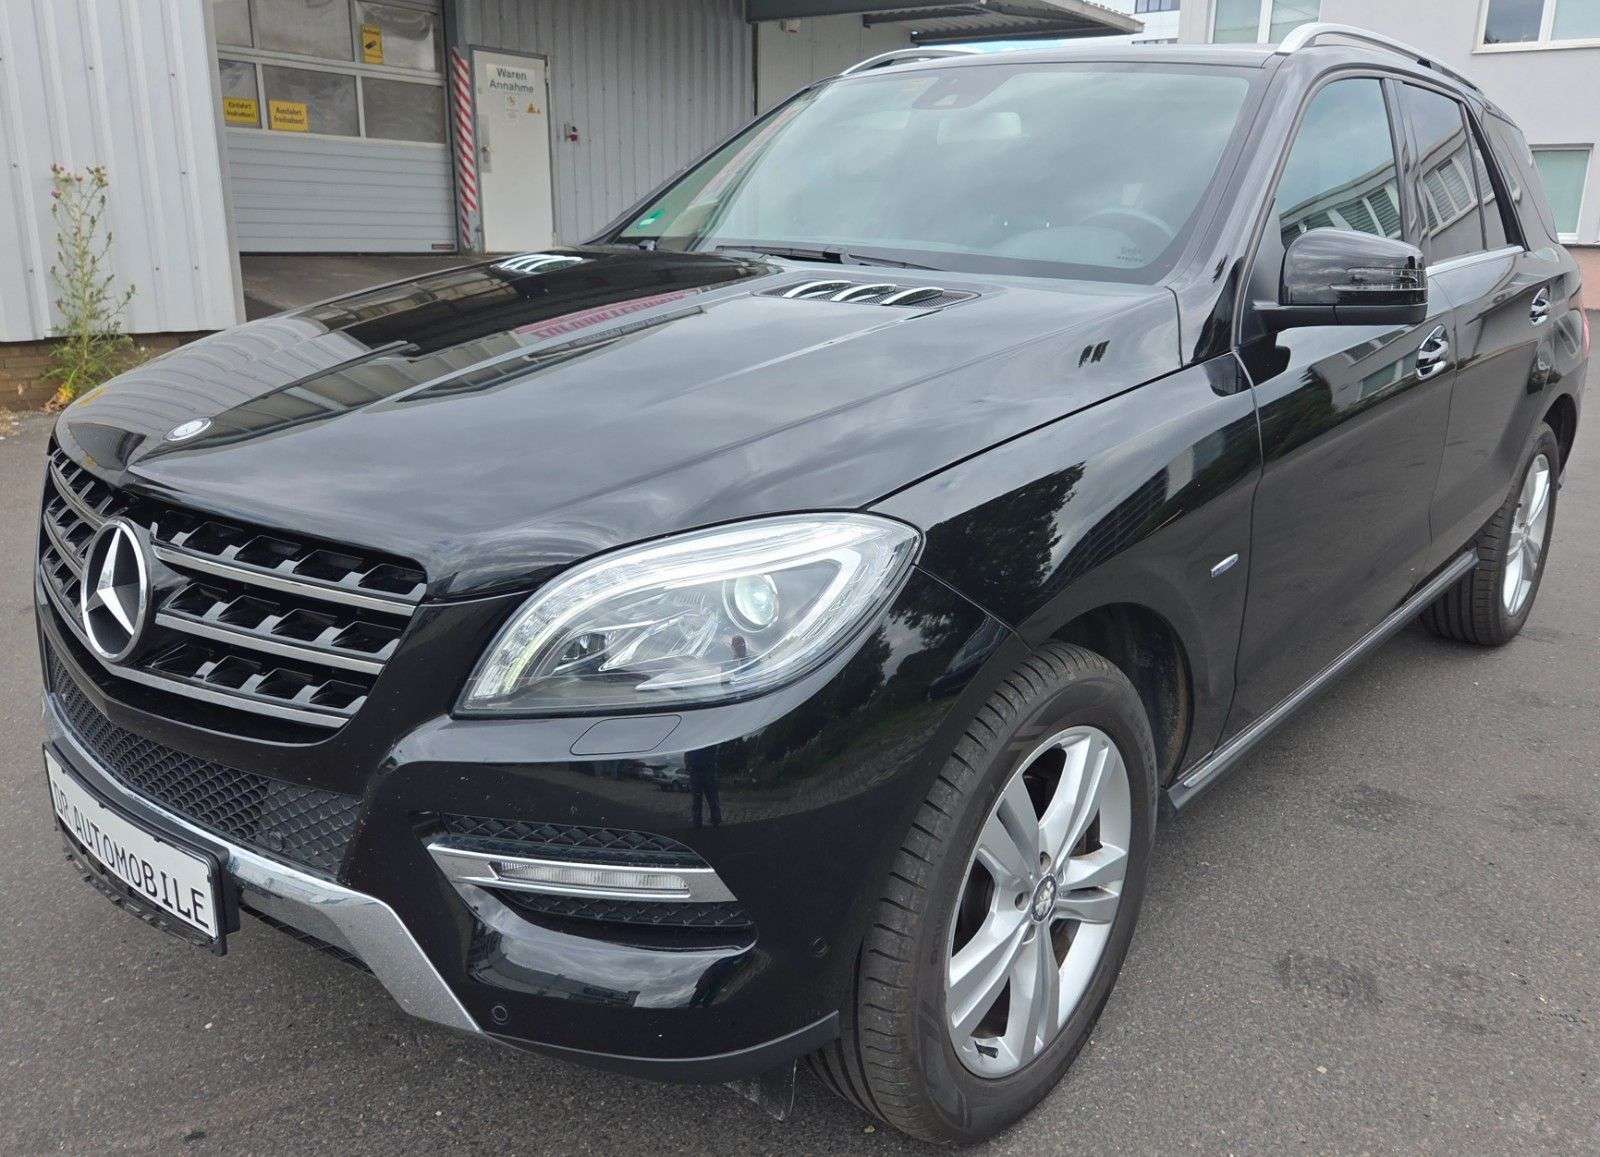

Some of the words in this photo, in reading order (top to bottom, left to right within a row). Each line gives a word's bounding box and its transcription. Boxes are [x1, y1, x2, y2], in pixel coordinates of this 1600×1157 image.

[496, 67, 527, 80] Waren
[489, 80, 534, 93] Annahme
[73, 804, 210, 929] AUTOMOBILE
